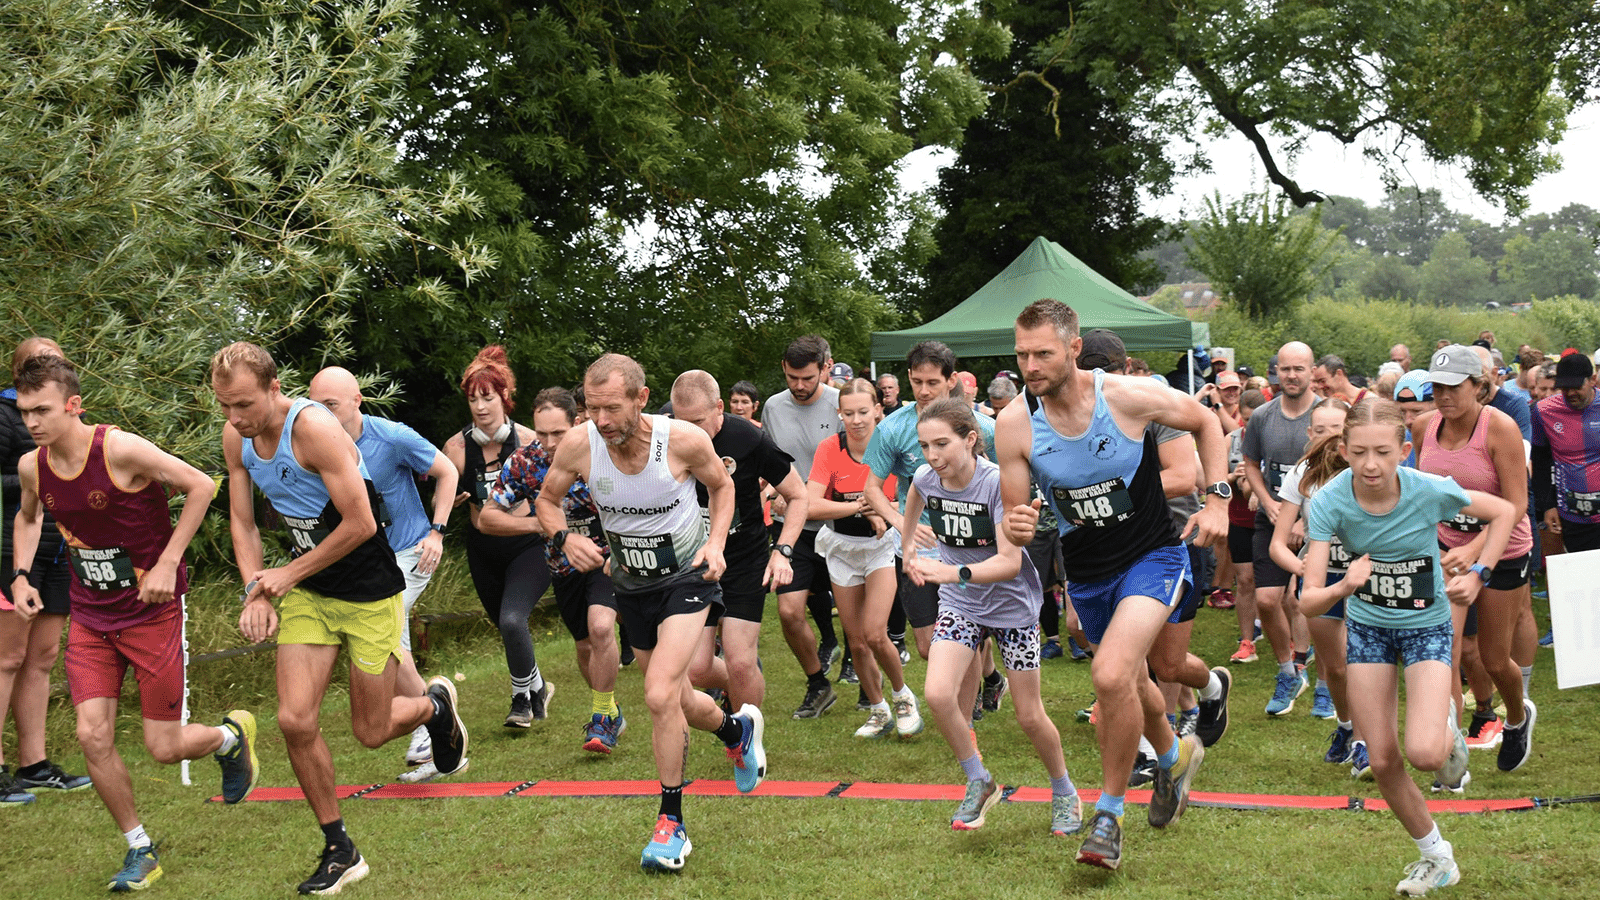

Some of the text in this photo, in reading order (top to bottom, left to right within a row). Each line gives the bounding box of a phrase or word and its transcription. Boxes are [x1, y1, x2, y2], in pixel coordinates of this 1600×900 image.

[655, 440, 663, 463] soar
[1101, 480, 1117, 489] HALL
[1071, 496, 1114, 520] 148
[941, 513, 973, 538] 179
[1094, 519, 1105, 527] 2K
[1117, 513, 1129, 522] 5K
[292, 529, 317, 550] 84
[955, 538, 965, 546] 2K
[621, 548, 658, 570] 100
[1407, 559, 1426, 567] HALL
[81, 560, 117, 582] 158
[1367, 574, 1412, 598] 183
[1386, 598, 1398, 607] 2K
